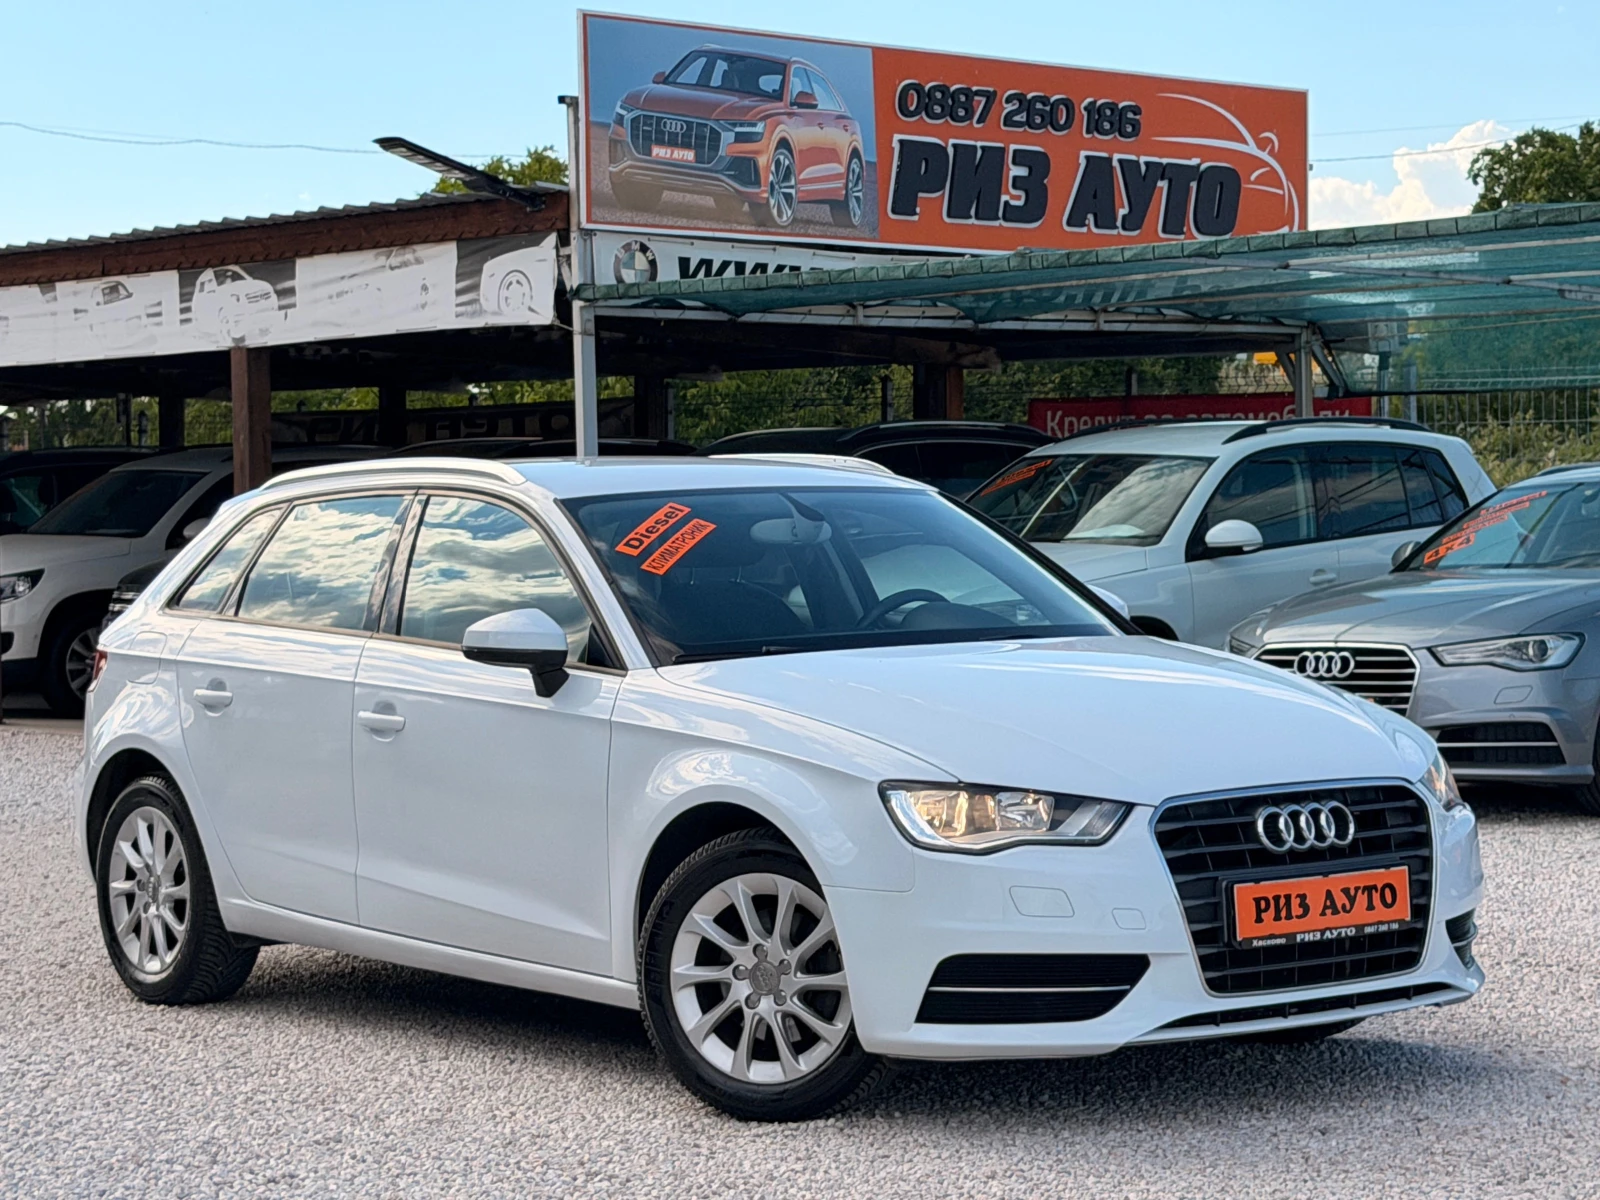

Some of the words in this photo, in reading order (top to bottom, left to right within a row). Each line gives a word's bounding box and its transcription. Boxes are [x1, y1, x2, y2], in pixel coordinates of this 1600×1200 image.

[895, 80, 997, 127] 0887
[1001, 90, 1075, 135] 260
[1082, 98, 1142, 141] 186
[888, 134, 1051, 227] РИЗ
[1063, 151, 1242, 239] АУТО
[623, 505, 685, 549] Diesel
[646, 521, 709, 571] КЛИМАТРОНИК
[1252, 893, 1310, 924] РИЗ
[1319, 882, 1397, 917] АУТО
[1252, 936, 1286, 947] Хасково
[1296, 931, 1321, 943] РИЗ
[1324, 926, 1356, 939] АУТО
